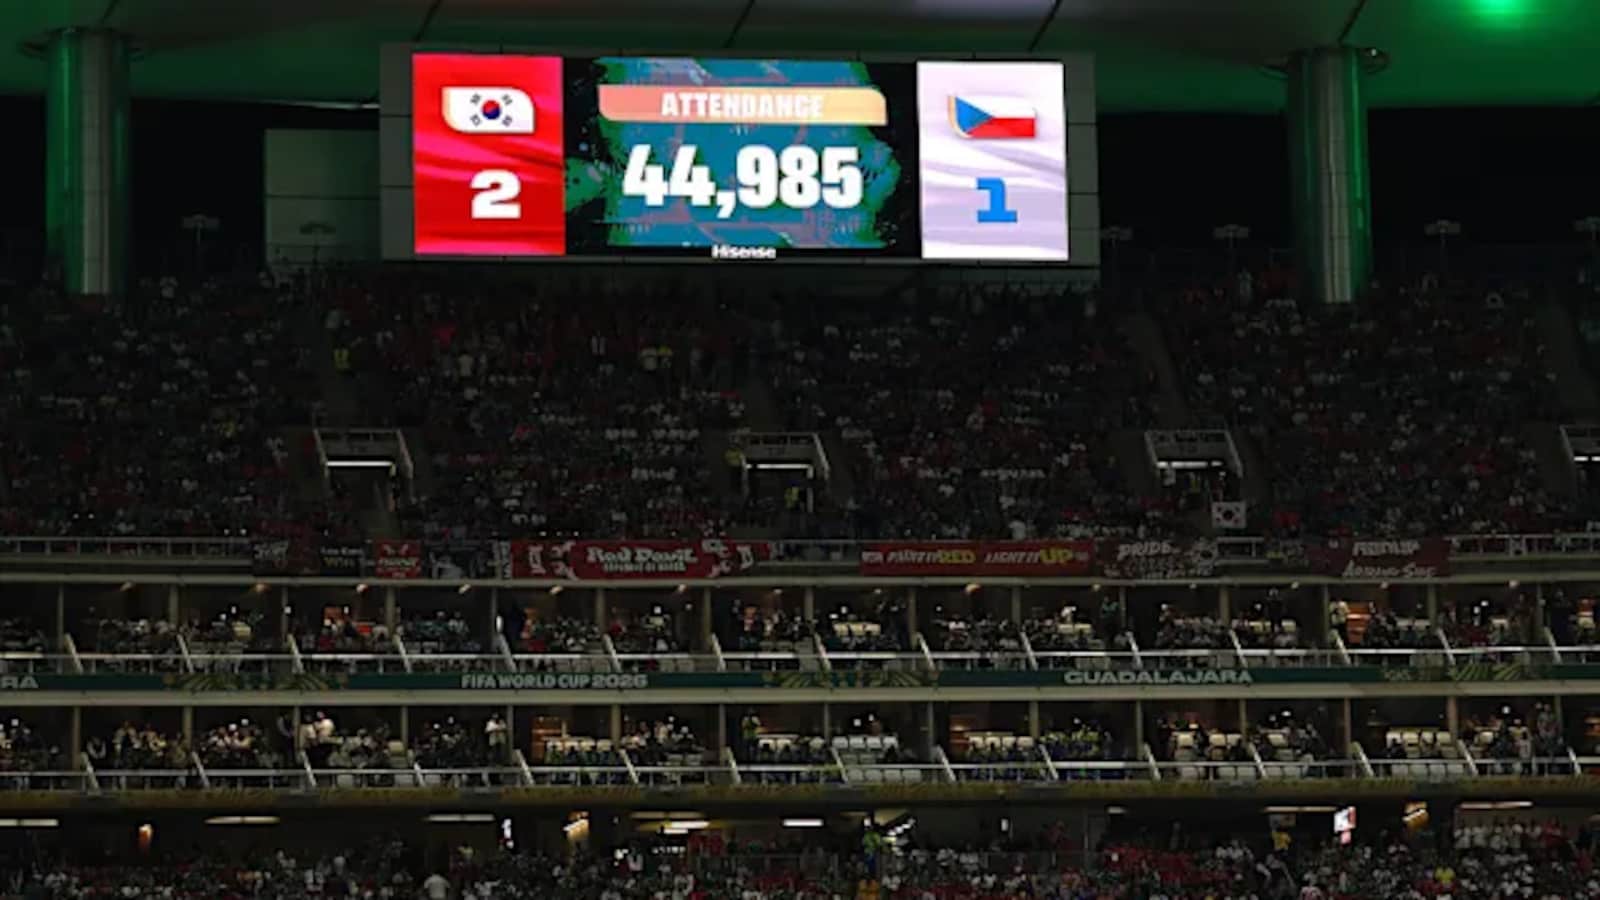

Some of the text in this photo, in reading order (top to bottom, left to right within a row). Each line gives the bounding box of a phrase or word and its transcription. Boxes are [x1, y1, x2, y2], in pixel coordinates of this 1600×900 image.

[661, 92, 824, 118] ATTENDANCE
[622, 144, 864, 218] 44,985
[470, 169, 522, 219] 2
[976, 177, 1018, 223] 1
[711, 244, 777, 259] Hisense
[1040, 548, 1074, 566] UP
[461, 674, 649, 688] FIFA WORLD CUP 2026
[1063, 669, 1253, 685] GUADALAJARA
